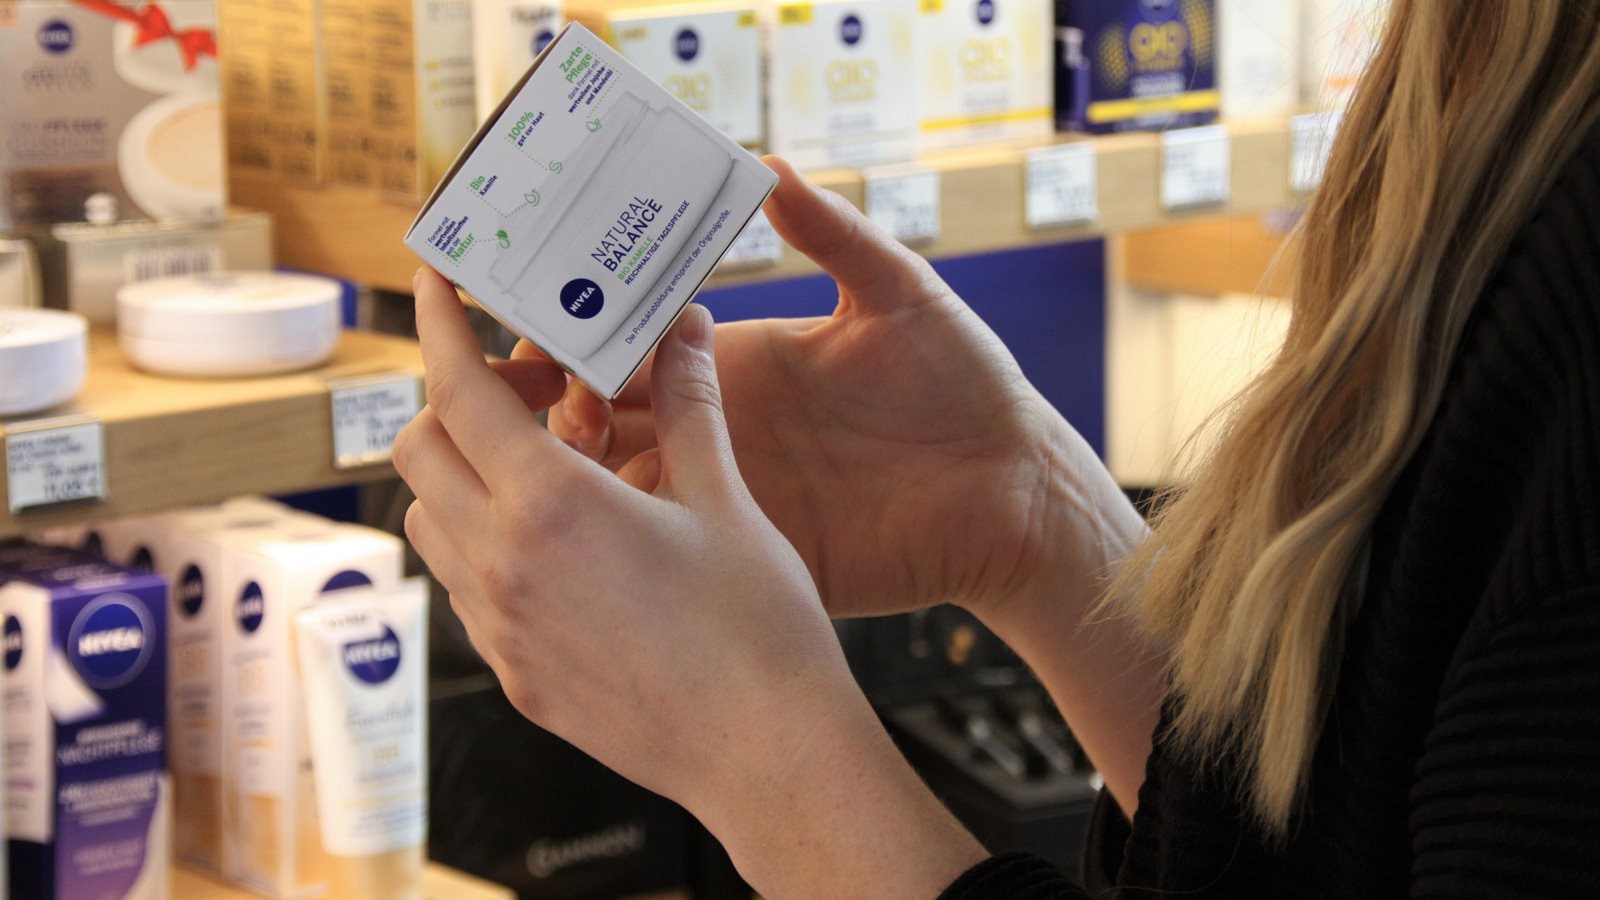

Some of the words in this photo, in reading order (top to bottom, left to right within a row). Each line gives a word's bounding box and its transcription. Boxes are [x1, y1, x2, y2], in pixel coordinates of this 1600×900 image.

[559, 46, 583, 73] Zarte
[565, 53, 593, 84] Pflege
[568, 87, 579, 100] dank
[576, 68, 593, 87] Formel
[591, 59, 600, 70] mit
[585, 93, 595, 105] und
[593, 69, 613, 94] Mandelöl
[568, 84, 592, 113] wertvollem
[507, 111, 534, 141] 100%
[517, 135, 527, 147] gut
[525, 125, 534, 136] zur
[531, 111, 545, 126] Haut
[470, 175, 485, 190] Bio
[479, 175, 497, 196] Kamille
[427, 225, 443, 243] Formel
[441, 216, 450, 227] mit
[434, 220, 456, 248] wertvollen
[591, 196, 649, 263] NATURAL
[603, 198, 663, 272] BALANCE
[624, 240, 661, 286] REICHHALTIGE
[657, 200, 690, 243] TAGESPFLEGE
[446, 245, 455, 256] aus
[452, 237, 461, 248] der
[450, 233, 475, 262] Natur
[617, 264, 631, 281] BIO
[629, 236, 654, 268] KAMILLE
[625, 331, 636, 345] Die
[632, 284, 674, 336] Produktabbildung
[670, 256, 695, 287] entspricht
[691, 246, 701, 260] der
[698, 209, 731, 249] Originalgröße.
[569, 286, 595, 312] NIVEA
[78, 626, 145, 658] NIVEA
[344, 639, 399, 666] NIVEA
